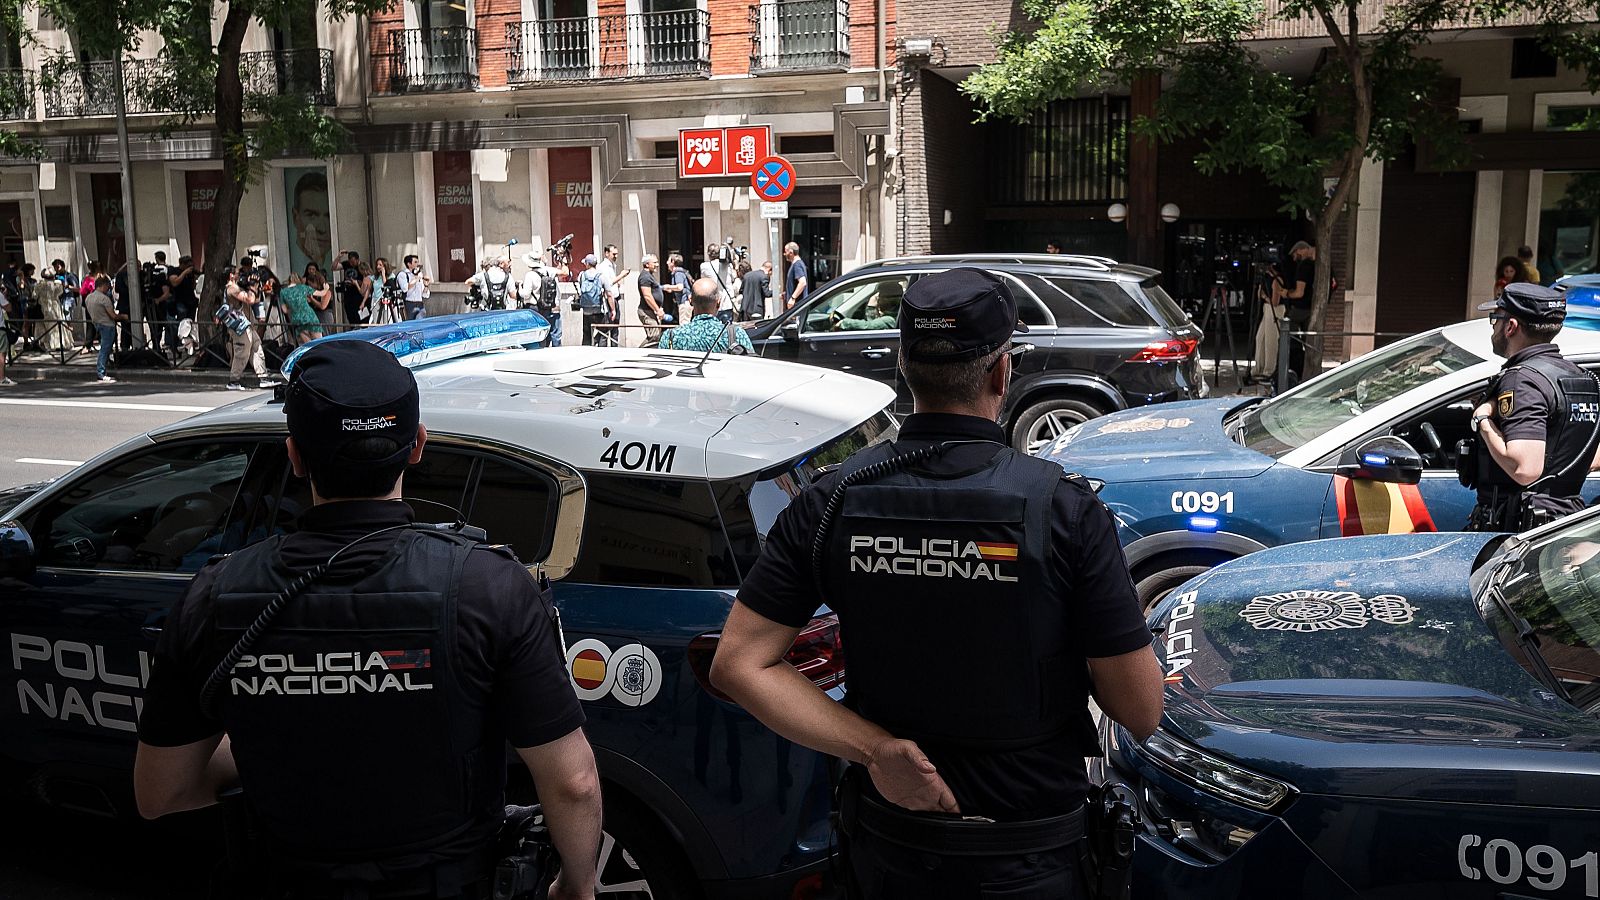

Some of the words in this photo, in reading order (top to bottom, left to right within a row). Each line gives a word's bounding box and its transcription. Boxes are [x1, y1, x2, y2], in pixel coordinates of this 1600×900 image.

[686, 137, 720, 153] PSOE
[342, 420, 397, 431] NACIONAL
[1182, 491, 1235, 514] 091
[850, 555, 1019, 582] NACIONAL
[1166, 590, 1199, 677] POLICÍA
[230, 672, 433, 696] NACIONAL
[1483, 838, 1599, 898] 091
